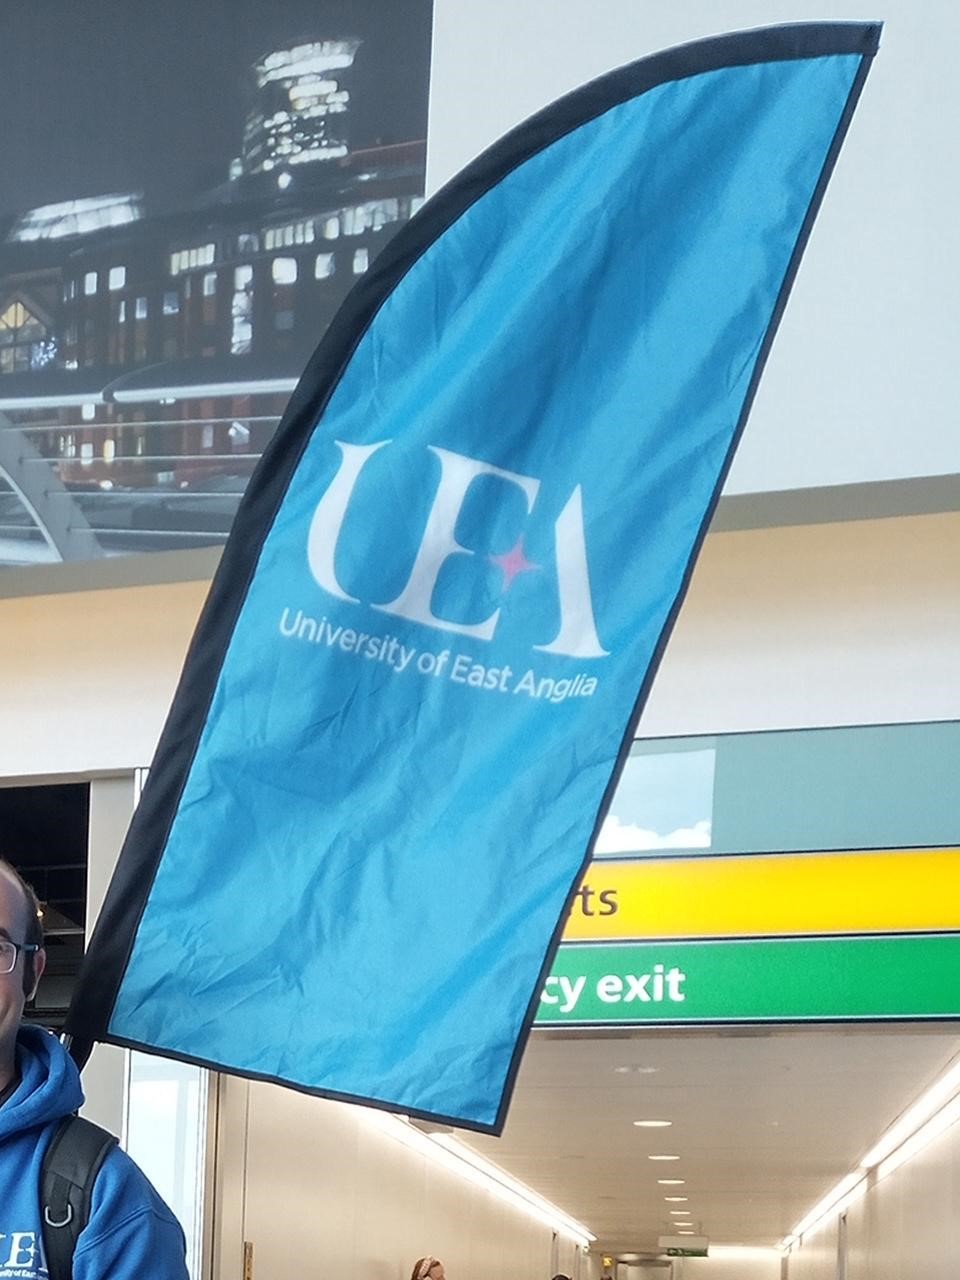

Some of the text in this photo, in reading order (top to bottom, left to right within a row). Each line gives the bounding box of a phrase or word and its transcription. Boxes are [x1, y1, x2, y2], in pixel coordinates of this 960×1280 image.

[307, 439, 611, 659] UEA
[279, 607, 598, 703] University of East Anglia
[574, 885, 618, 916] ts
[596, 964, 686, 1003] exit
